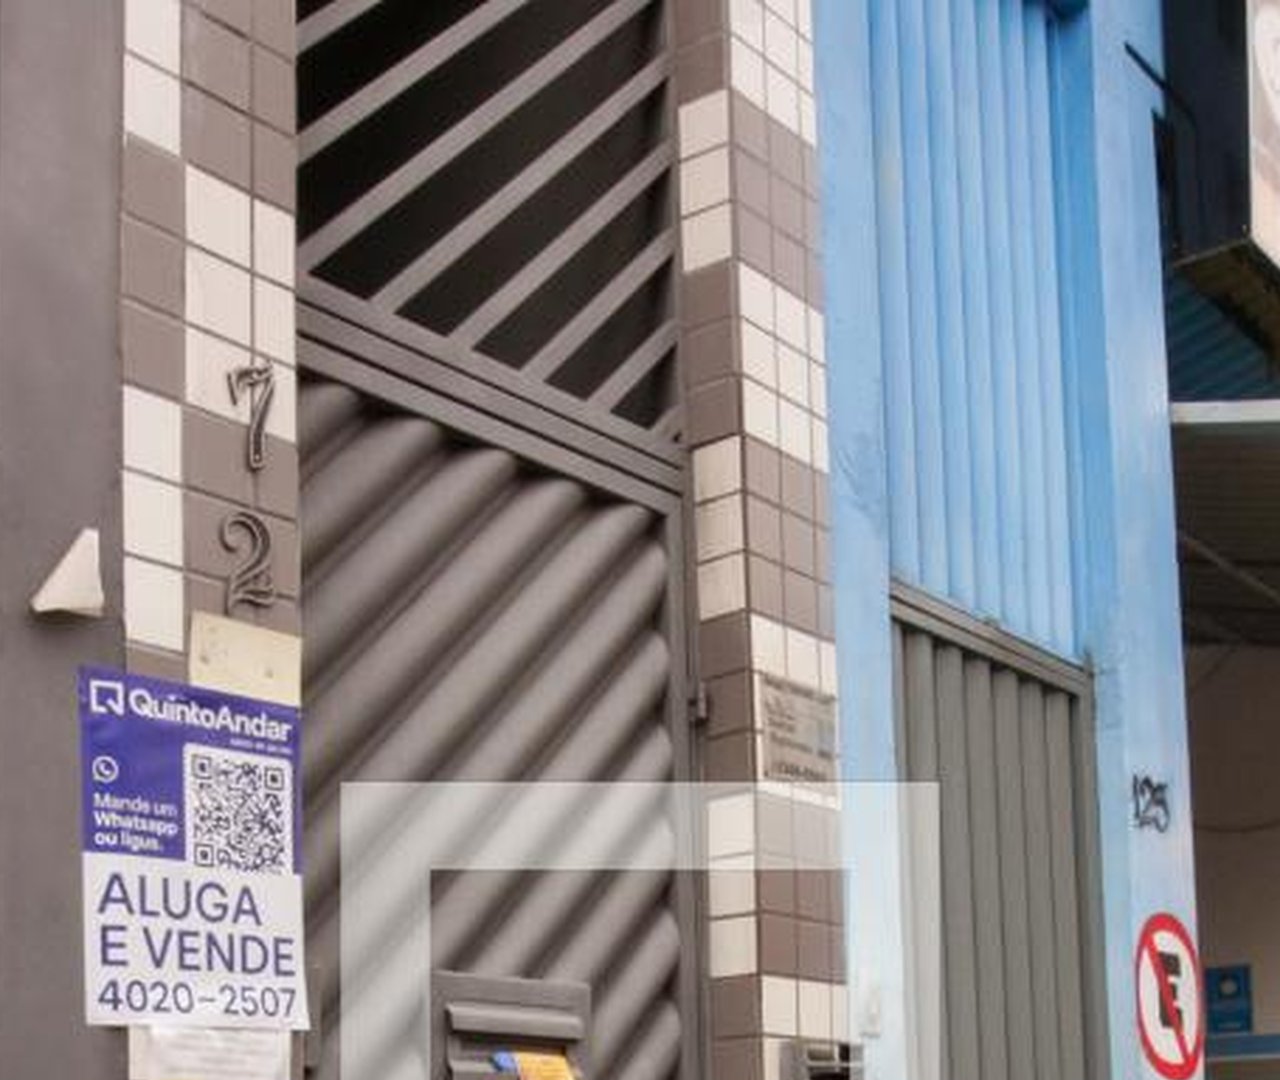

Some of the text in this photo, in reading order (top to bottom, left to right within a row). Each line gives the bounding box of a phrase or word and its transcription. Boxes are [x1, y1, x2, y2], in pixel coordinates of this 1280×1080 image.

[129, 688, 293, 742] QuintoAndar
[94, 832, 118, 846] ou
[98, 872, 262, 926] ALUGA
[100, 924, 296, 977] E VENDE
[98, 979, 297, 1017] 4020-2507
